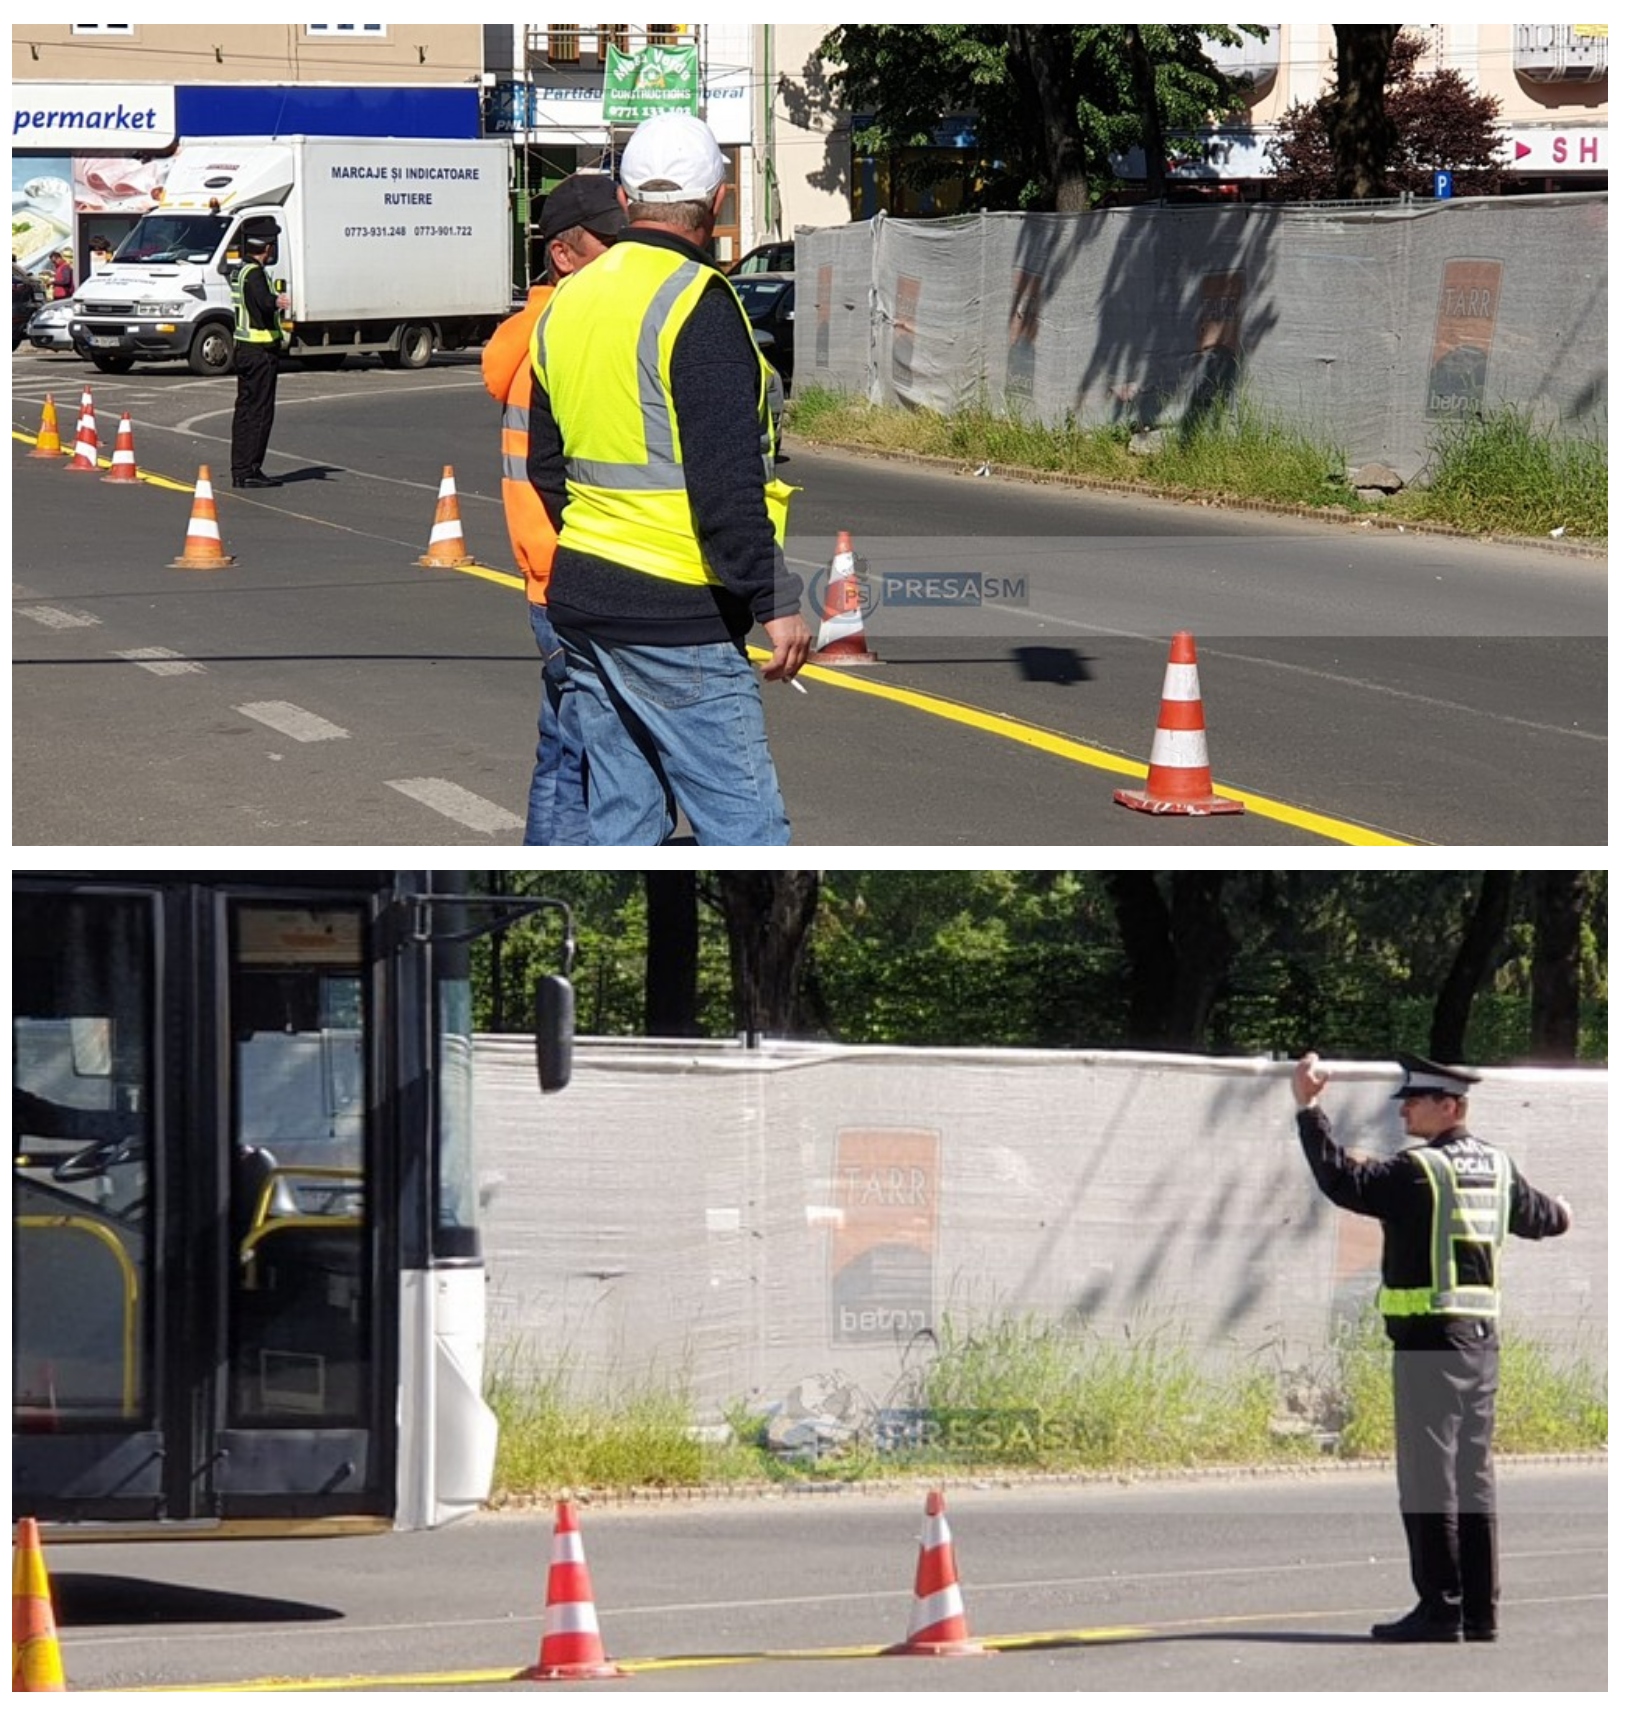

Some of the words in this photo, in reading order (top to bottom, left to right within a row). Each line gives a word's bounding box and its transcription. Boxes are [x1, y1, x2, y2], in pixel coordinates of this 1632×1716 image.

[544, 86, 603, 100] Partidu
[698, 86, 744, 99] iberal
[611, 87, 691, 99] CONSTRUCTIONS
[609, 105, 639, 118] 0771
[13, 104, 156, 135] permarket
[495, 119, 524, 131] PNL
[331, 166, 387, 179] MARCAJE
[406, 167, 480, 180] INDICATOARE
[1438, 175, 1447, 195] P
[384, 193, 433, 205] RUTIERE
[344, 226, 407, 237] 0773-931.248
[414, 225, 472, 236] 0773-901.722
[1444, 287, 1491, 317] TARR
[844, 1167, 926, 1206] TARR
[840, 1304, 925, 1332] beton
